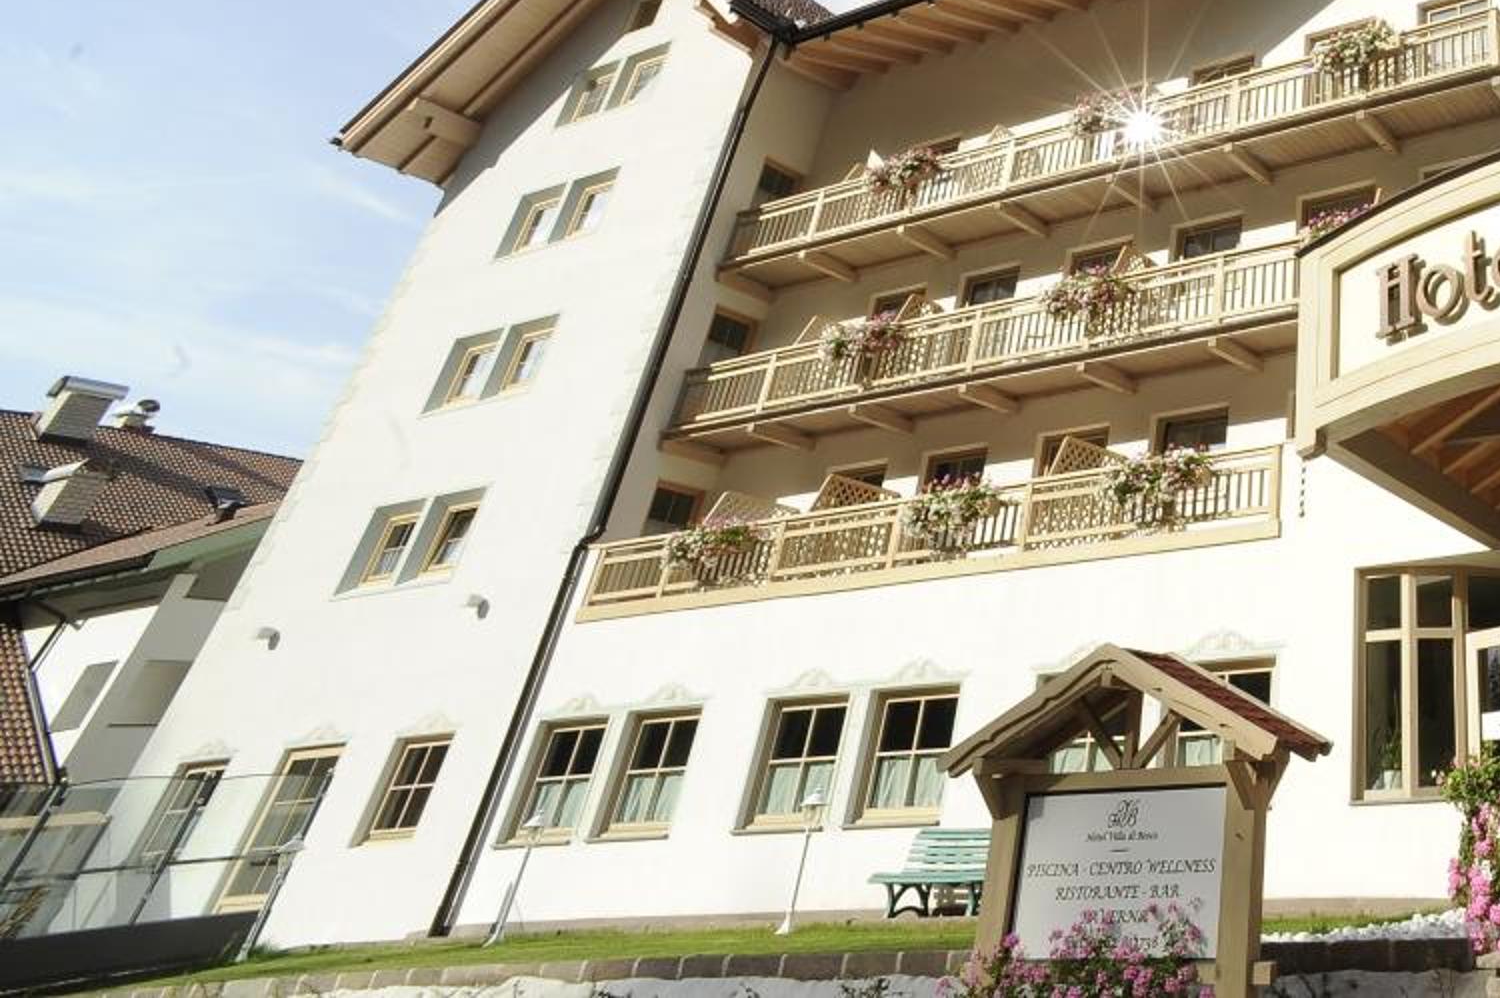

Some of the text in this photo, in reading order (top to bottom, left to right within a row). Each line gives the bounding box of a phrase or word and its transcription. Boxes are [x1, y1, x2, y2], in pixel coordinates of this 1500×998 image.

[1027, 863, 1080, 877] PISCINA
[1089, 860, 1143, 876] CENTRO
[1147, 858, 1216, 875] WELLNESS
[1055, 885, 1140, 901] RISTORANTE
[1149, 884, 1180, 899] BAR
